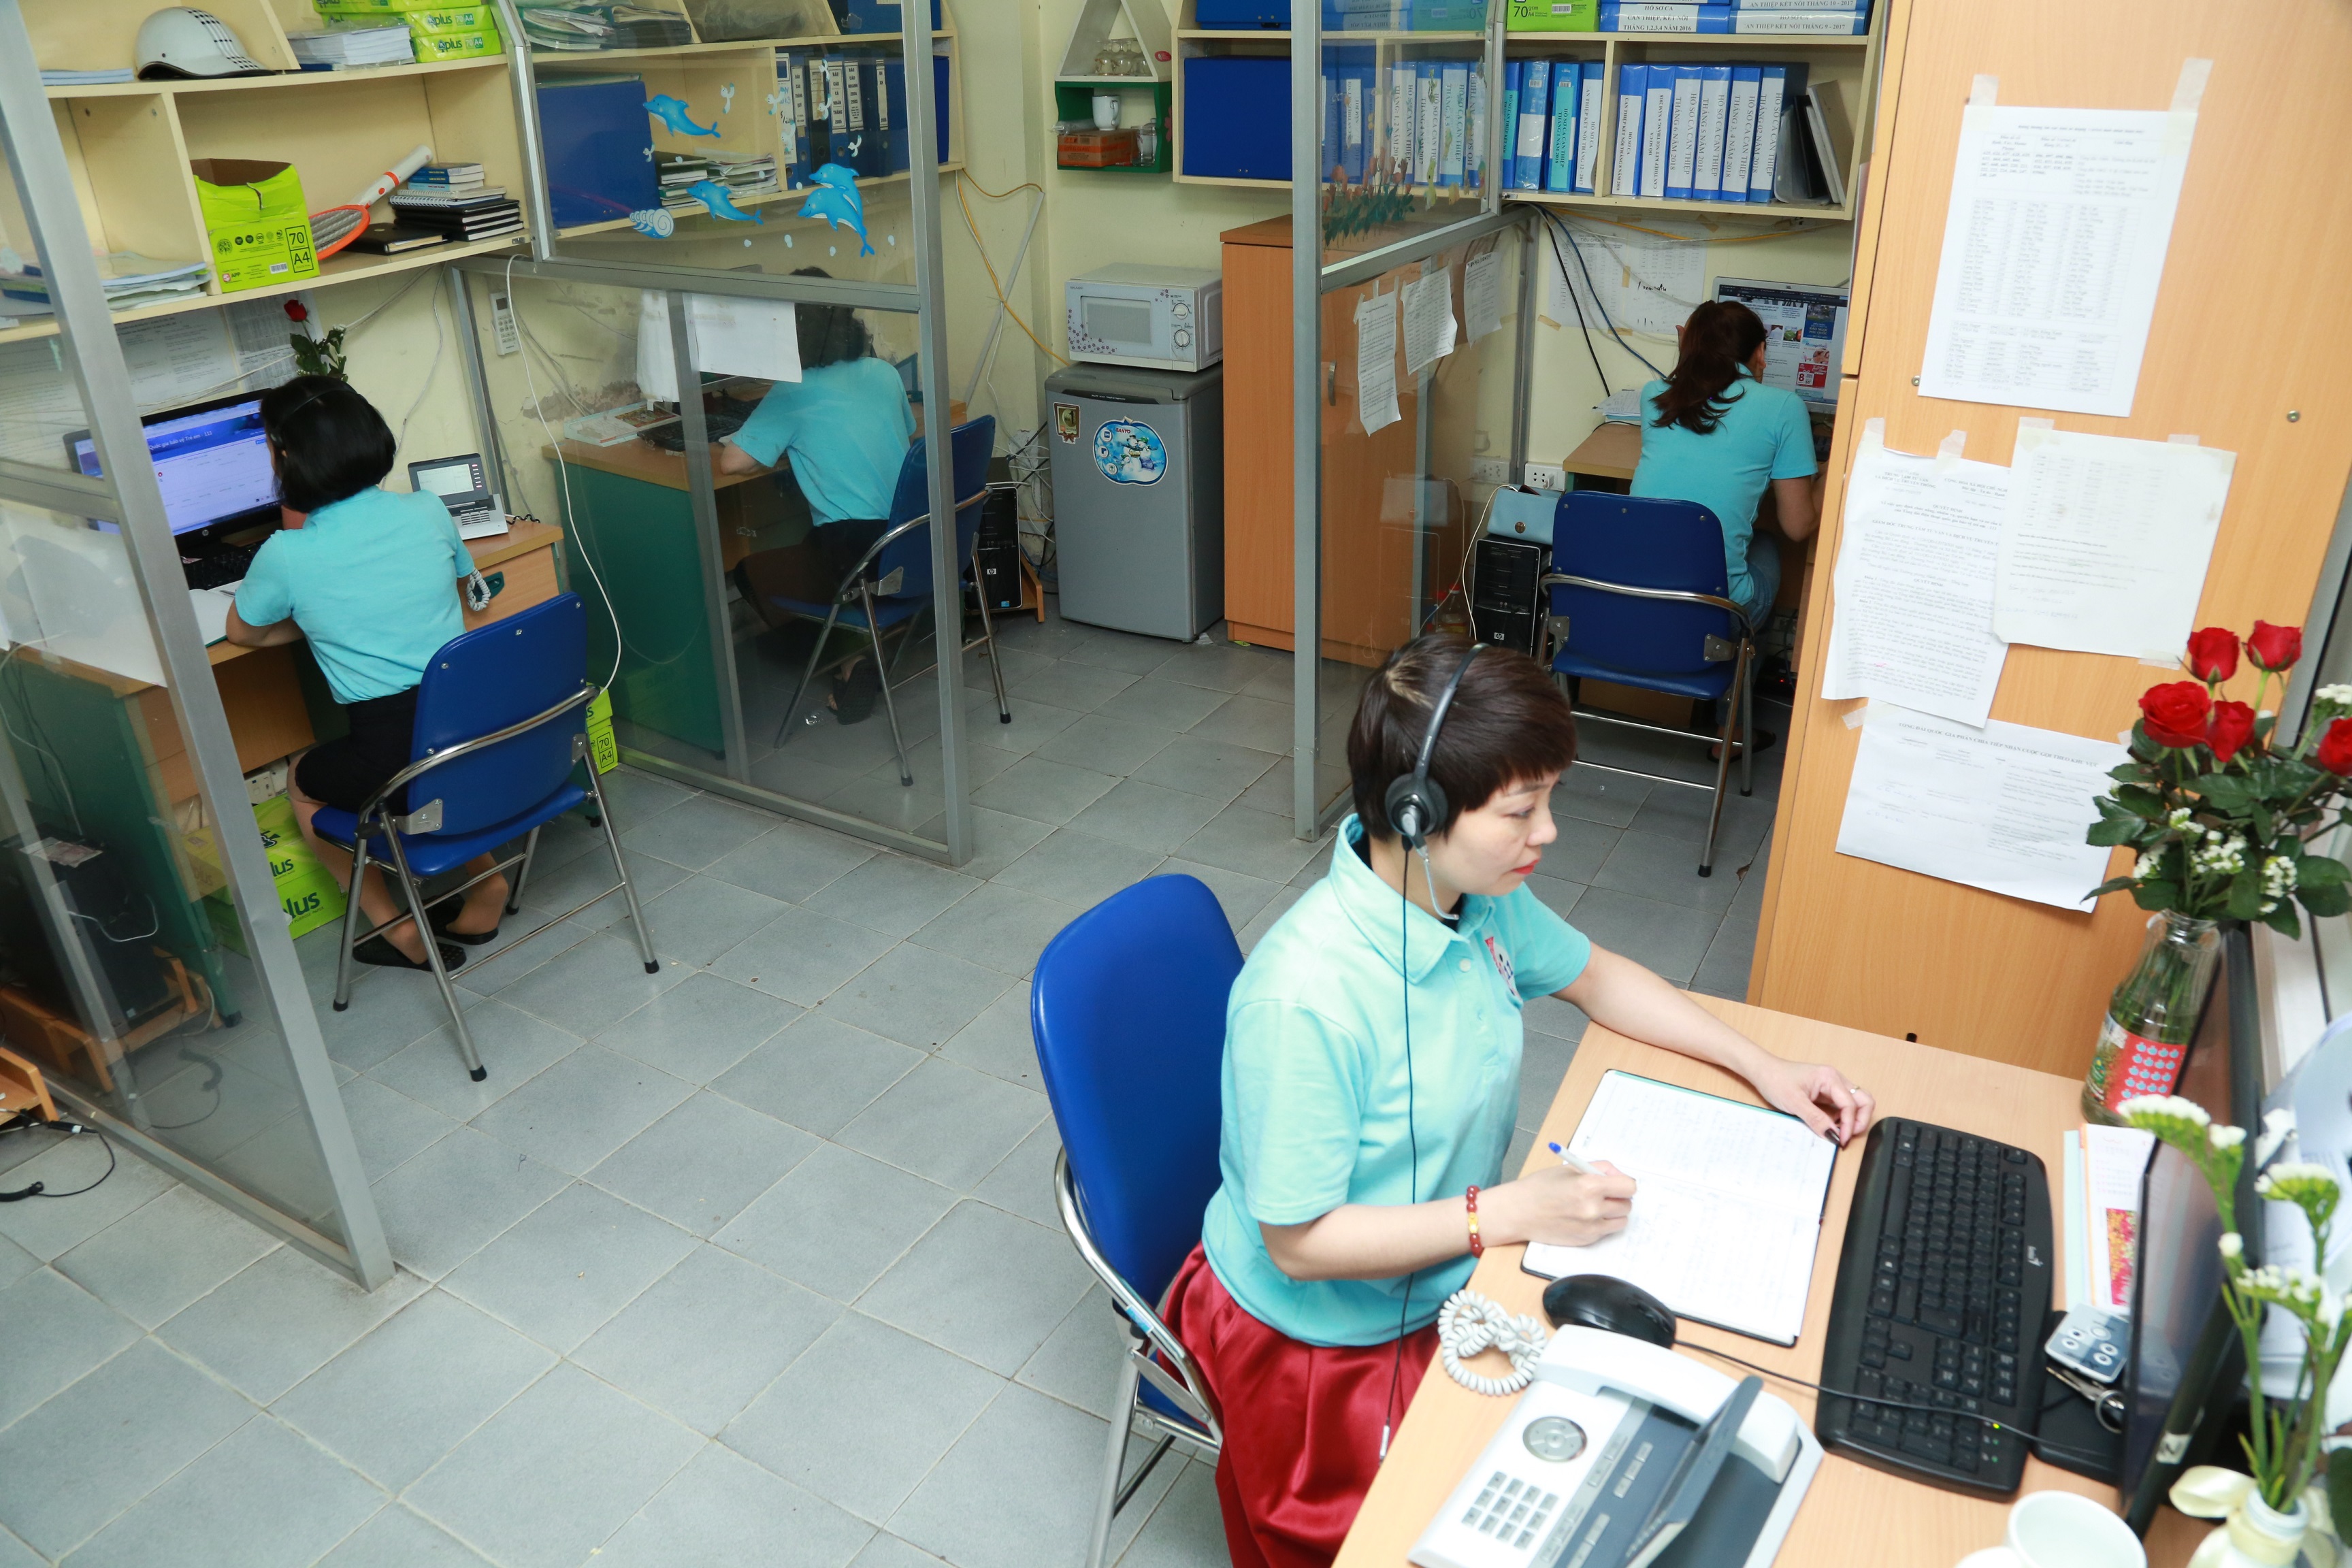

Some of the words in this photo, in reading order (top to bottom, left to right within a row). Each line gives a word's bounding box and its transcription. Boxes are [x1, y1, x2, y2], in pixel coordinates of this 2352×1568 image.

[1514, 6, 1528, 17] 70
[446, 38, 463, 52] plus
[1690, 93, 1697, 105] HỒ
[1718, 95, 1725, 107] HỒ
[1748, 96, 1756, 108] HỒ
[1673, 97, 1682, 125] THÁNG
[1700, 99, 1710, 127] THÁNG
[1716, 109, 1723, 119] SƠ
[1731, 95, 1741, 124] THÁNG
[1746, 110, 1754, 121] SƠ
[1758, 95, 1767, 122] THÁNG
[1687, 120, 1693, 131] CA
[1715, 121, 1720, 133] CA
[1744, 123, 1752, 134] CA
[1757, 125, 1763, 133] 02
[1771, 120, 1778, 131] CA
[1589, 140, 1594, 148] CA
[1698, 135, 1706, 154] NĂM
[1727, 141, 1735, 159] NĂM
[1754, 136, 1763, 154] NĂM
[1683, 152, 1692, 174] THIỆP
[1711, 154, 1719, 176] THIỆP
[1739, 157, 1748, 179] THIỆP
[1766, 154, 1775, 176] THIỆP
[289, 231, 304, 245] 70
[293, 251, 310, 265] A4
[599, 737, 609, 749] 70
[602, 751, 612, 762] A4
[270, 859, 294, 877] lus
[283, 892, 320, 919] lus
